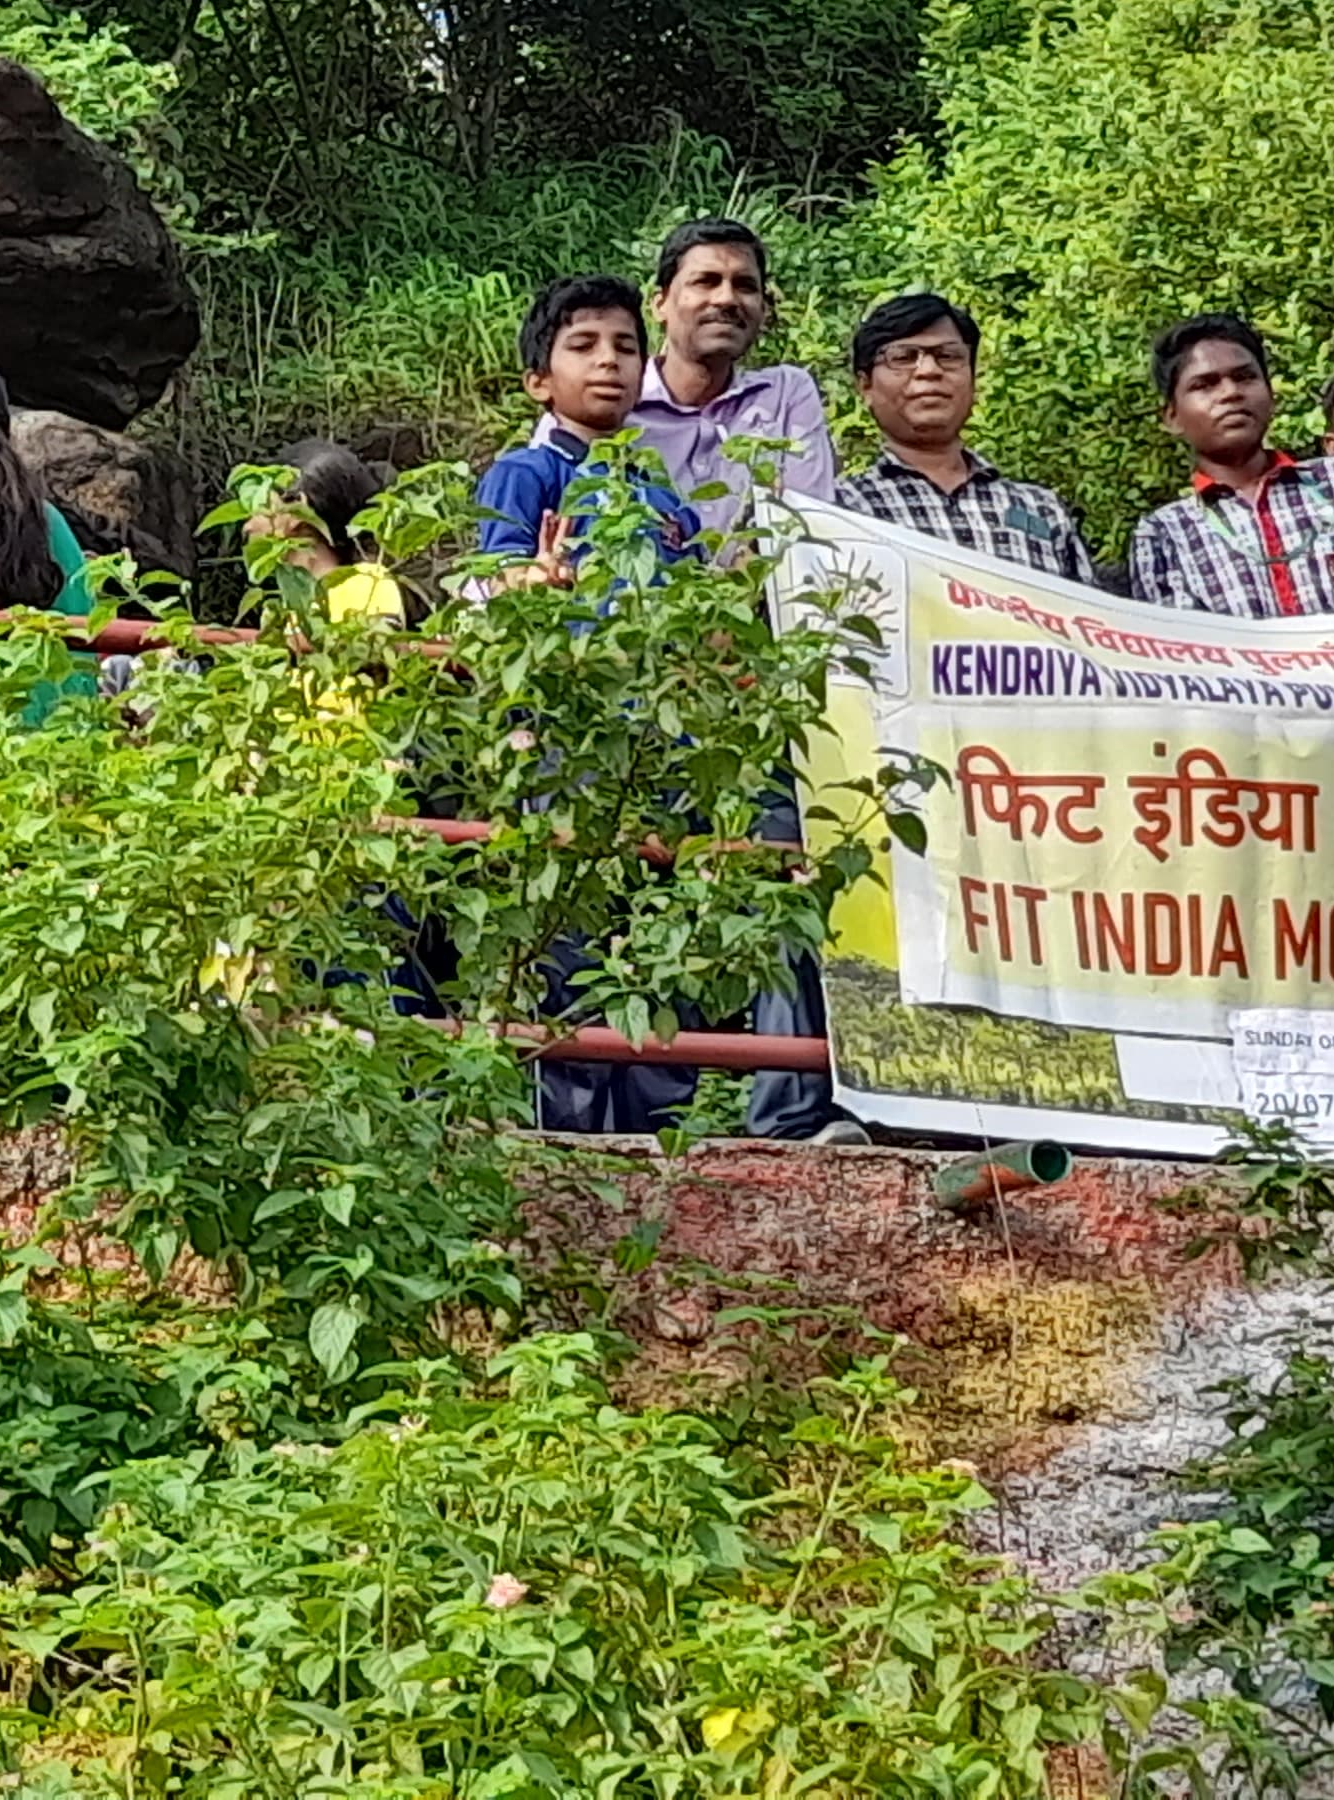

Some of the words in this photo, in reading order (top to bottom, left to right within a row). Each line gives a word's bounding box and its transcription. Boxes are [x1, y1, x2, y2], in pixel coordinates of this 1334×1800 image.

[1072, 616, 1233, 666] विद्यालय
[933, 645, 1101, 696] KENDRIYA
[1101, 665, 1285, 706] VIDYALAYA
[956, 745, 1105, 843] फिट
[1128, 742, 1319, 862] इंडिया
[960, 876, 1047, 965] FIT
[1072, 891, 1249, 979] INDIA
[1245, 1030, 1312, 1047] SUNDAY
